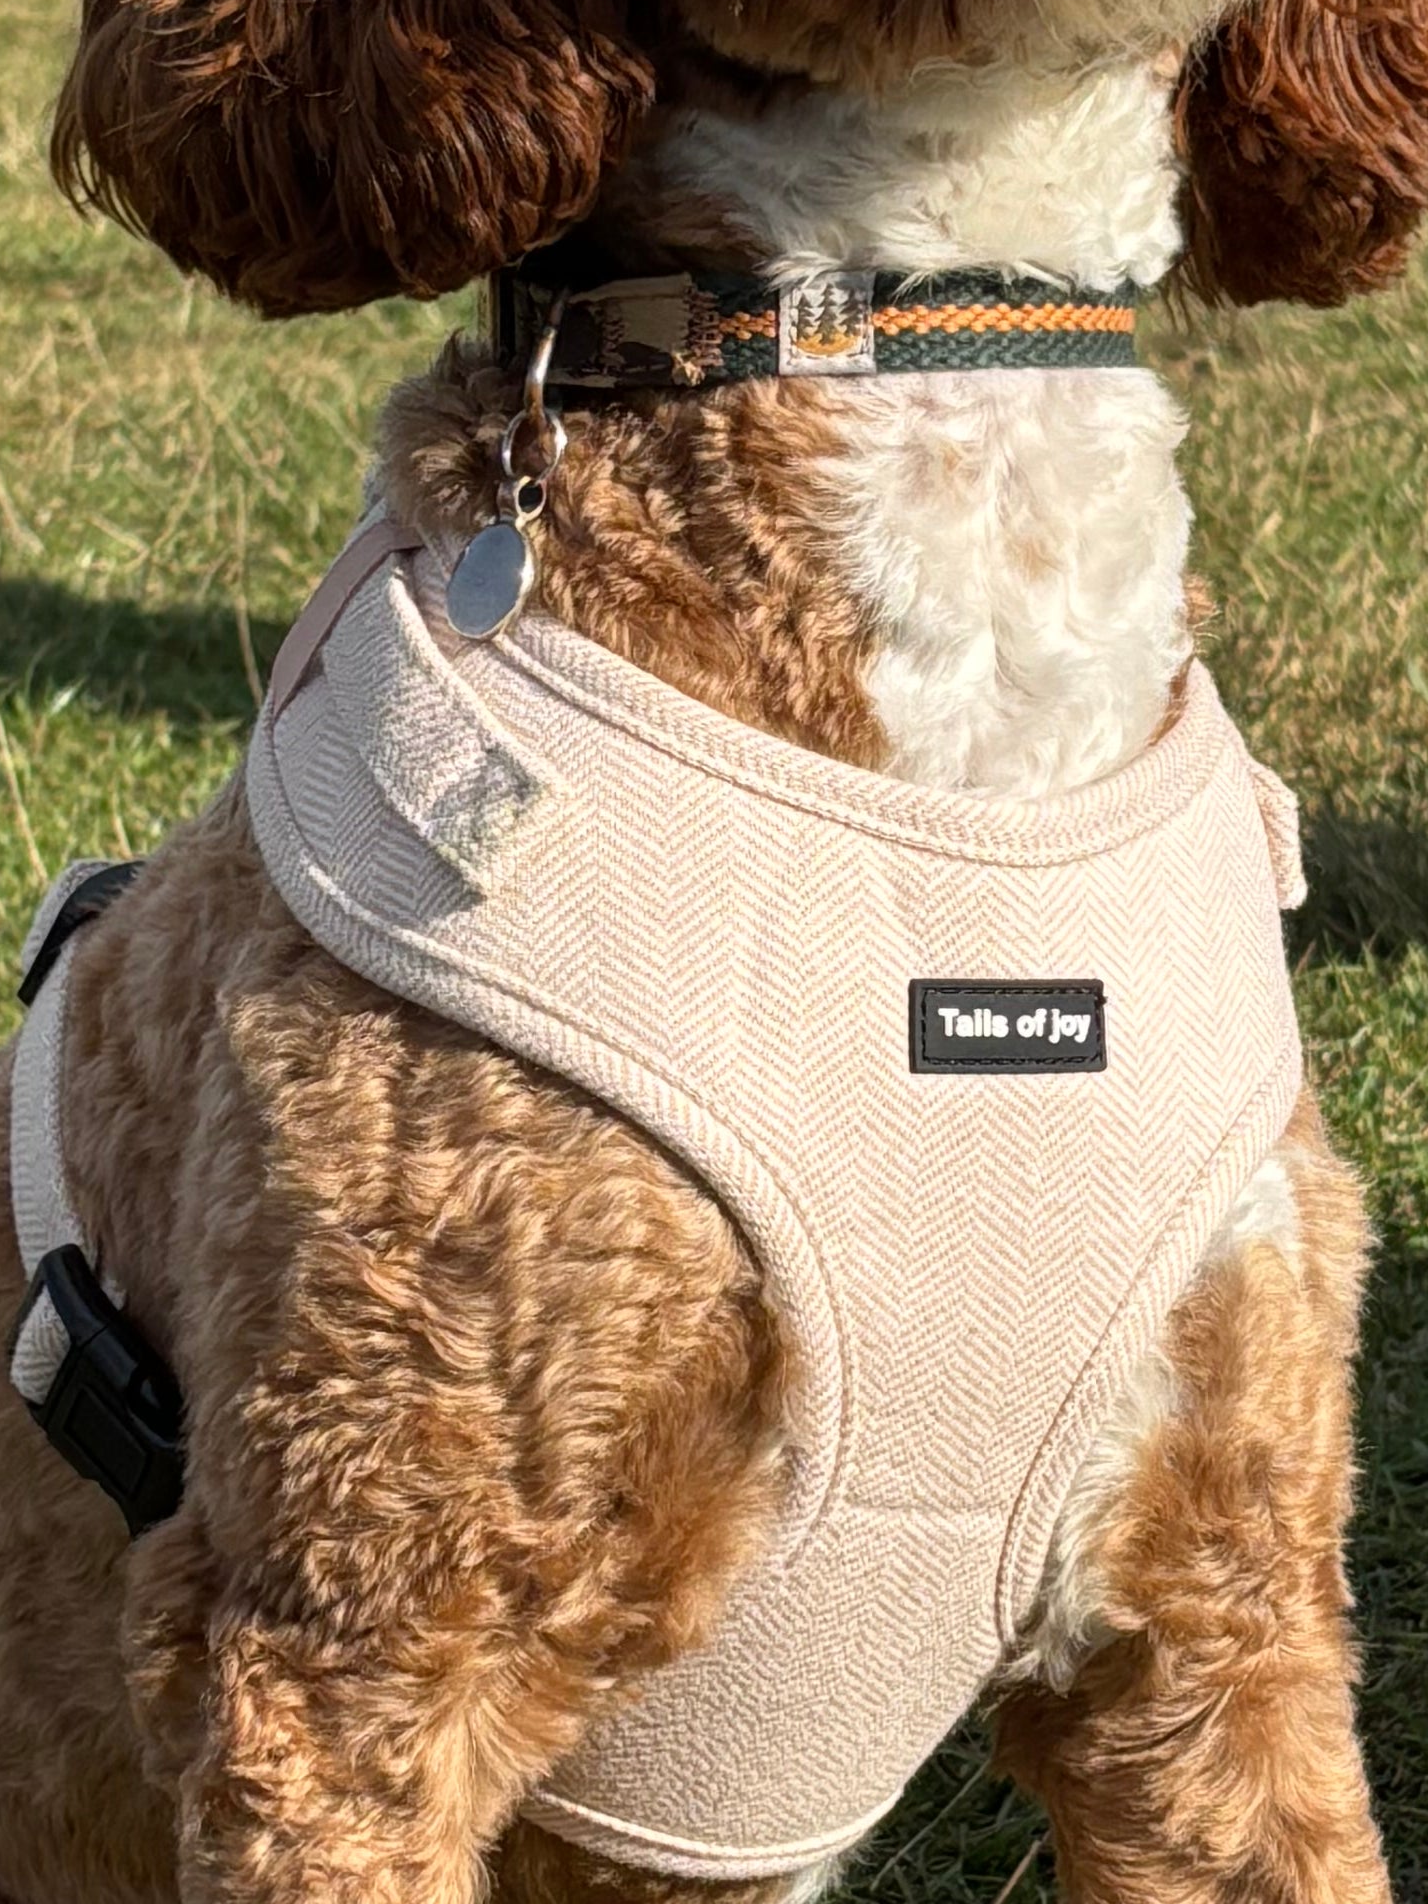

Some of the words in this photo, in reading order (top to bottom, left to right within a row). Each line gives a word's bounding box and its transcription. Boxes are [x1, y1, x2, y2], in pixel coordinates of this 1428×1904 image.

[937, 1007, 1009, 1038] Tails
[1016, 1007, 1047, 1038] of
[1048, 1007, 1091, 1044] joy
